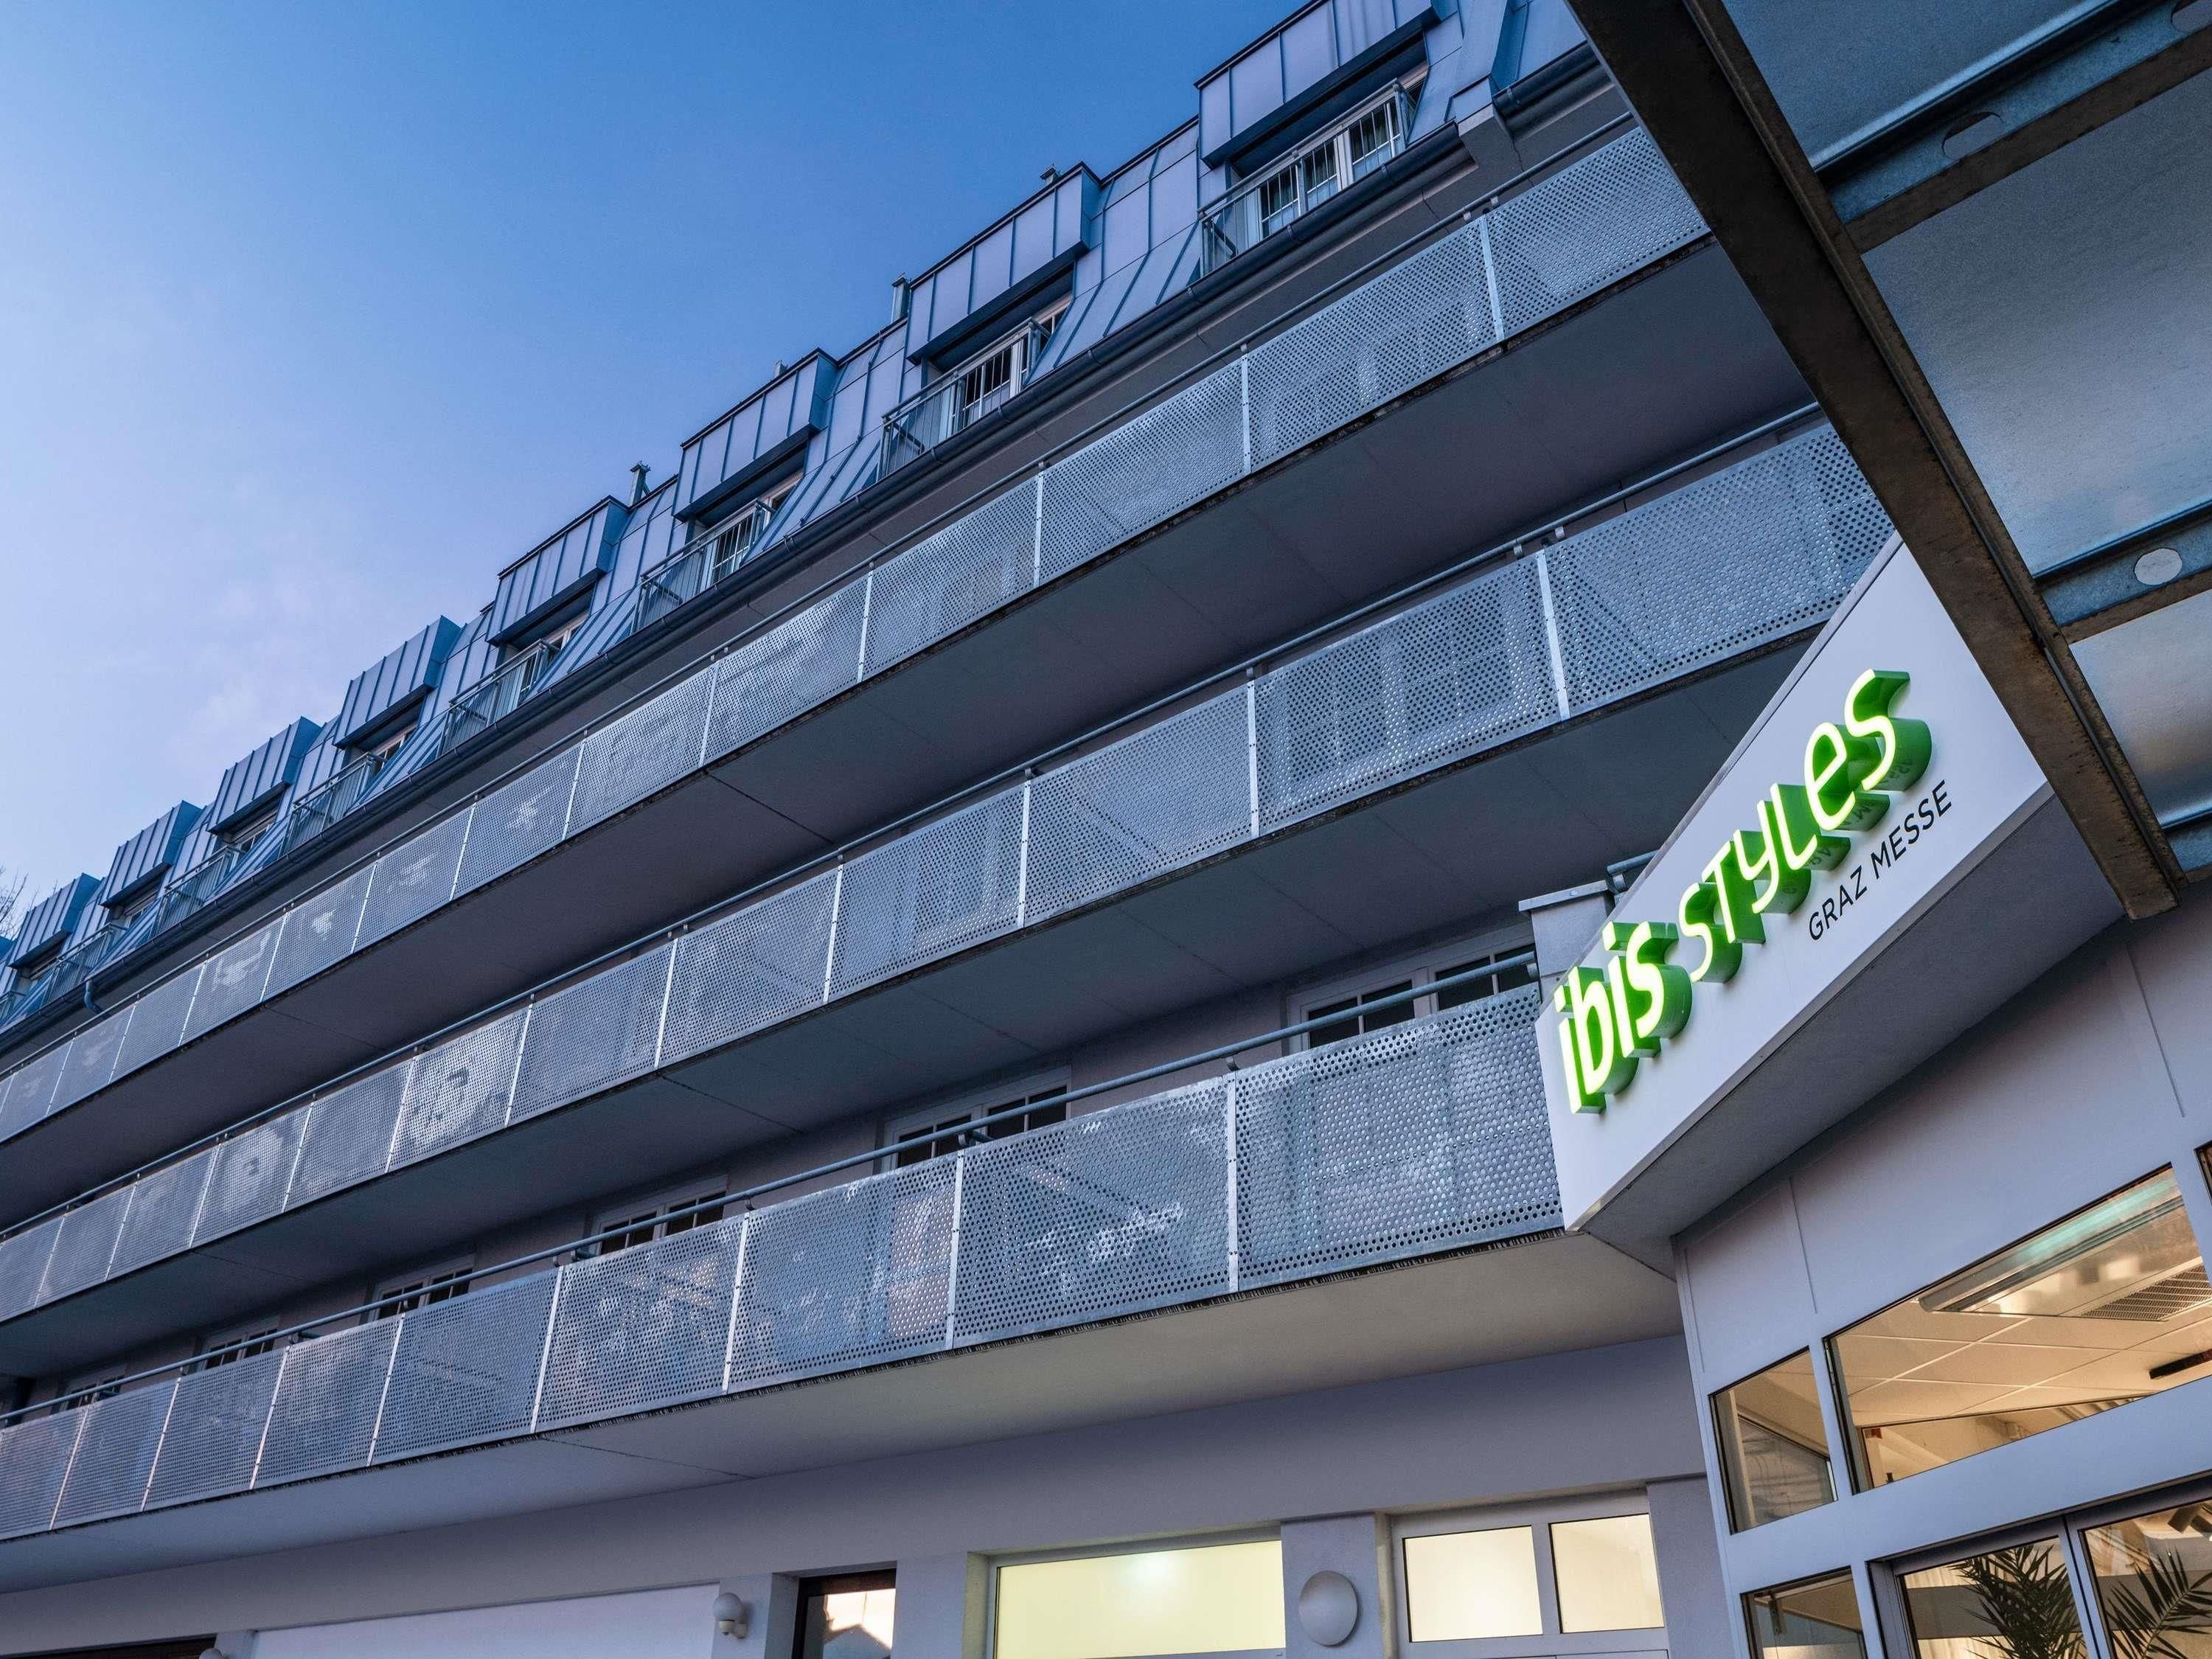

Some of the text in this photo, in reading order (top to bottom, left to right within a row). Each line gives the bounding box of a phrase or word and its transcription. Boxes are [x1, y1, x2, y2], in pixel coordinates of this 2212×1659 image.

[1809, 865, 1868, 941] GRAZ
[1870, 779, 1952, 880] MESSE
[1554, 921, 1665, 1114] ibis
